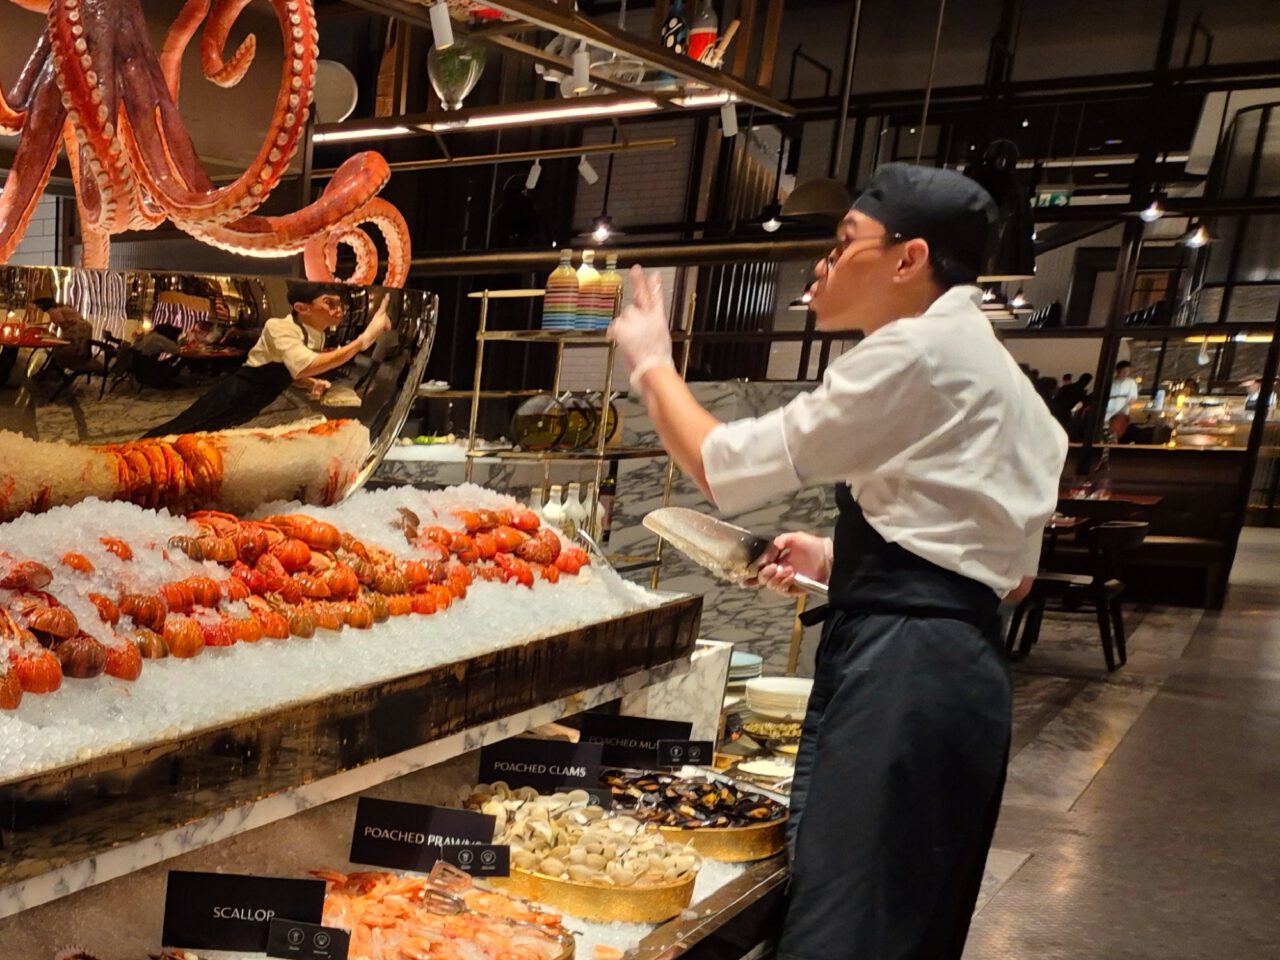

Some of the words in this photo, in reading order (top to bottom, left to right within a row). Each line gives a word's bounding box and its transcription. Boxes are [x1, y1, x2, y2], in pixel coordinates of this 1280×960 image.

[494, 761, 547, 775] POACHED
[549, 765, 588, 778] CLAMS
[364, 826, 425, 845] POACHED
[213, 906, 276, 922] SCALLOP
